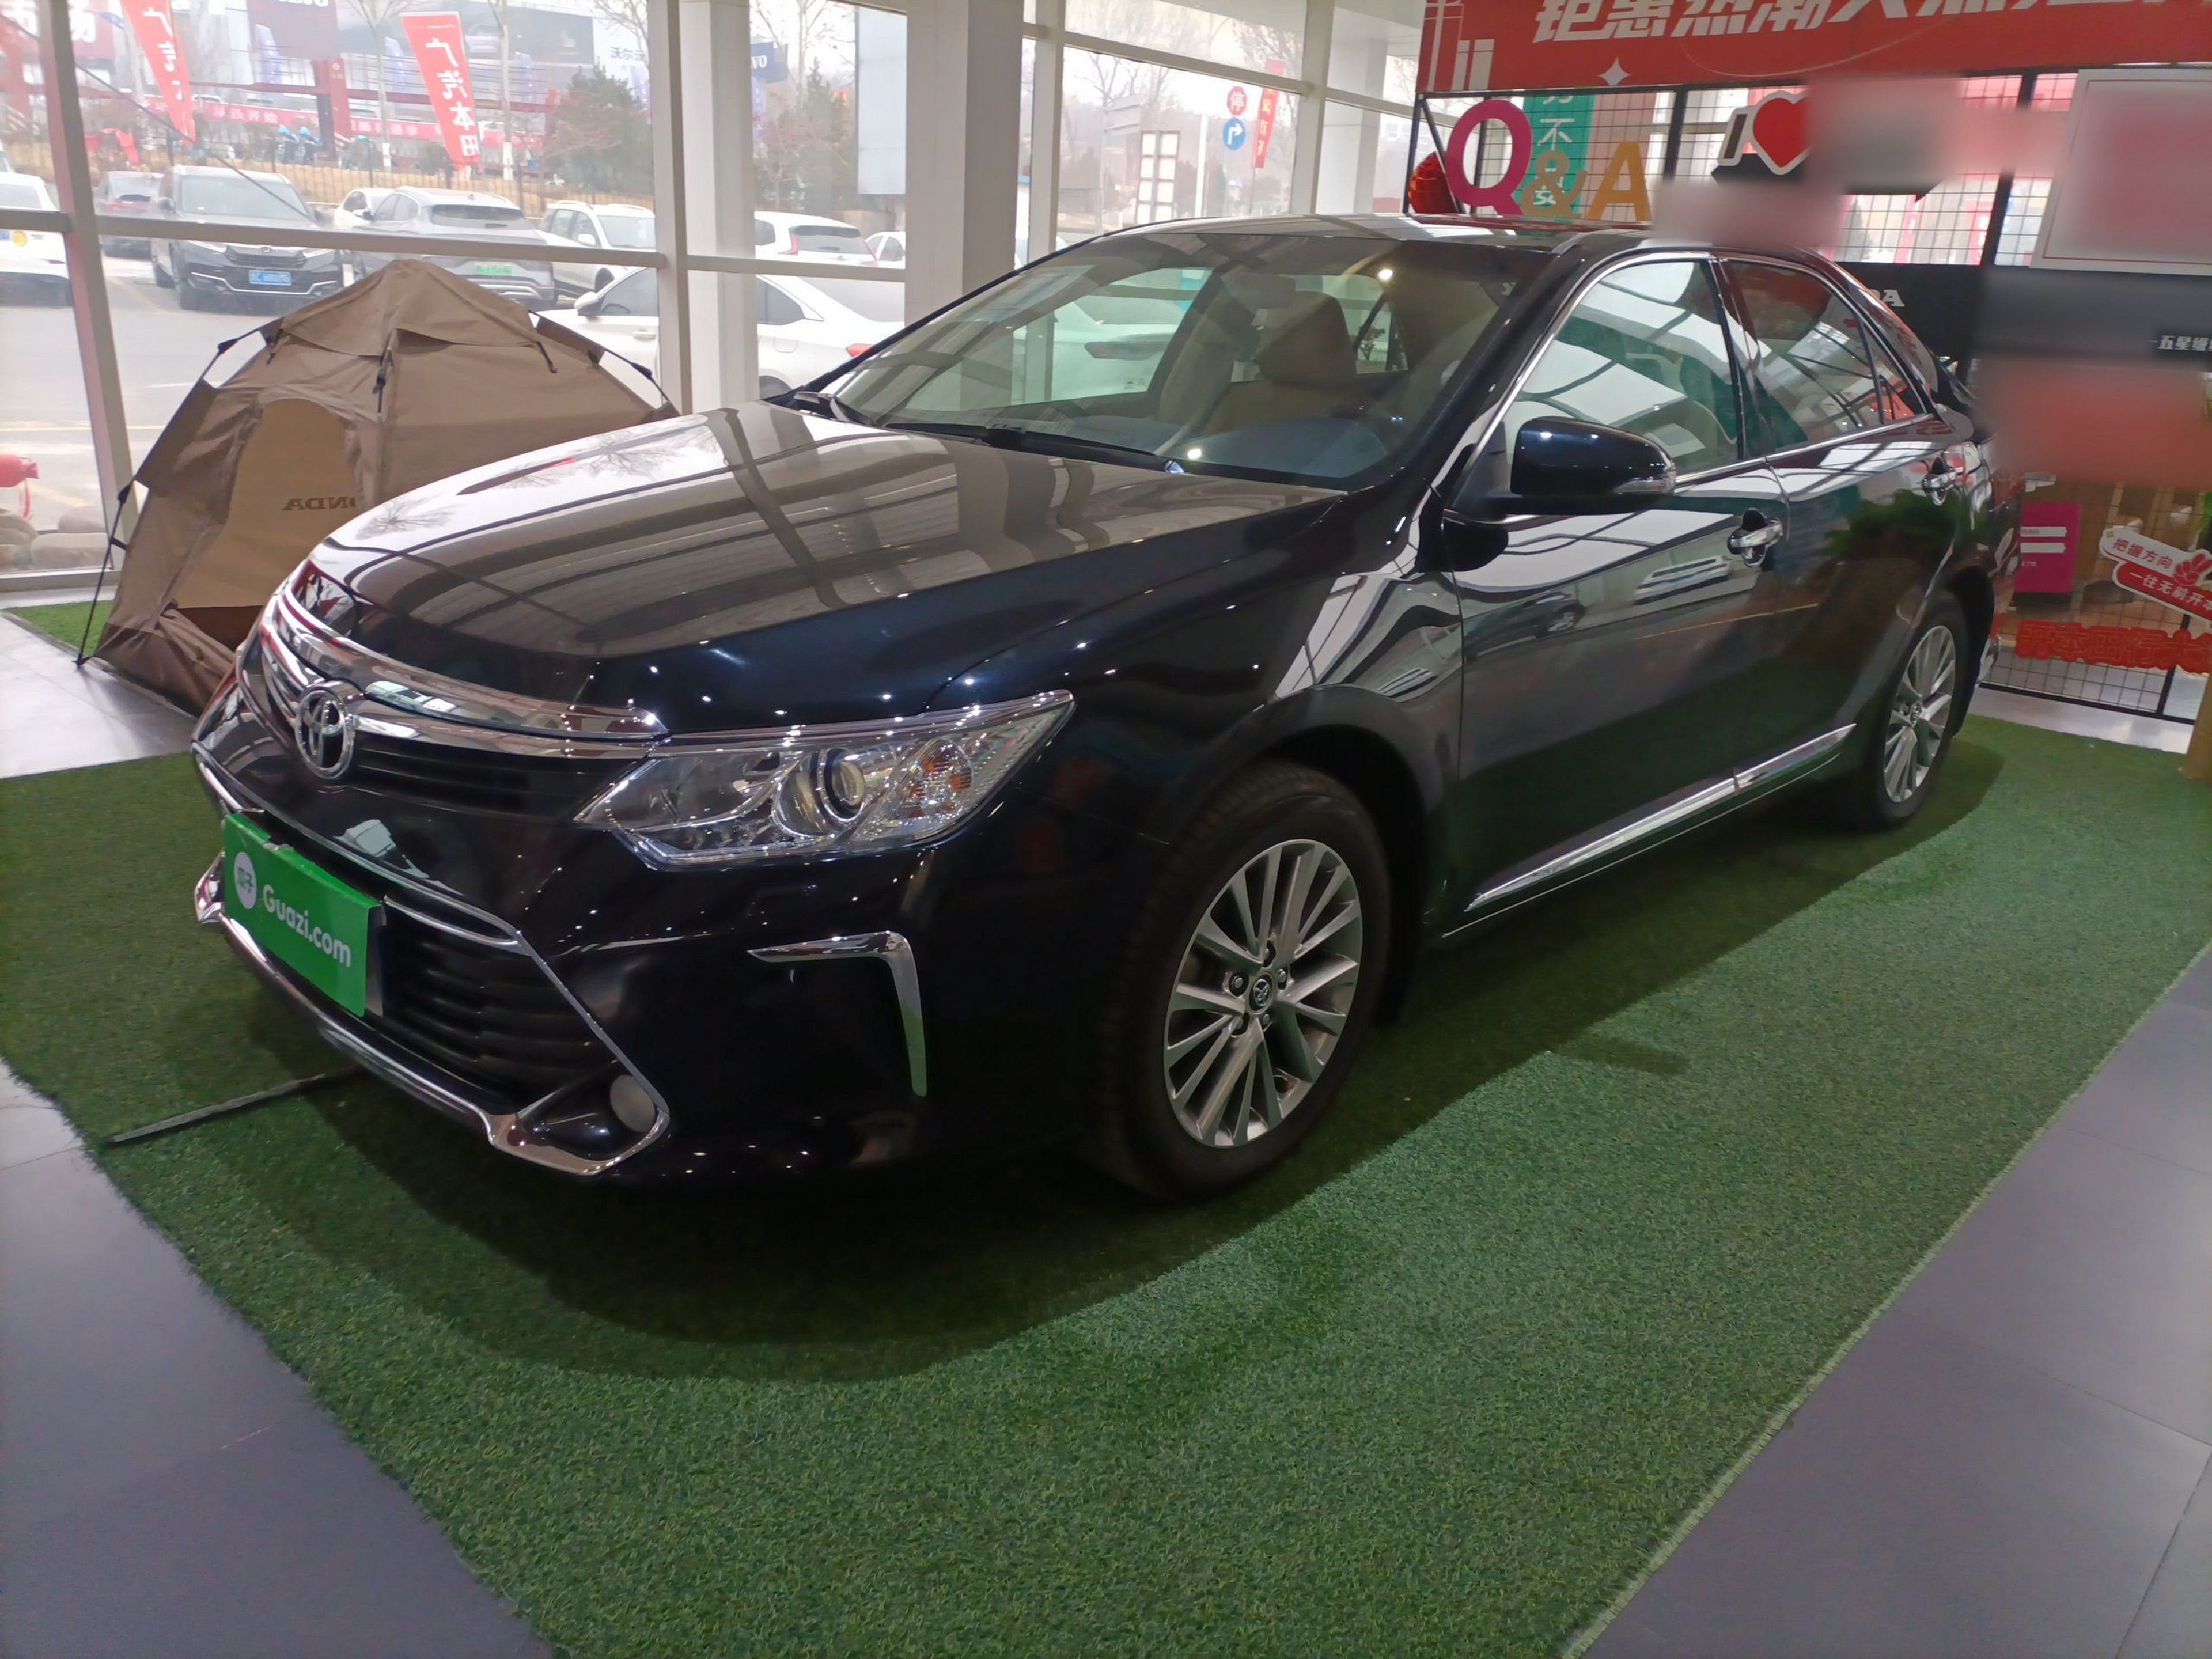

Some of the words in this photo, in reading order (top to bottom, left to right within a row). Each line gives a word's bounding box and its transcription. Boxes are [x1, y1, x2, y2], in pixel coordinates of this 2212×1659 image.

[1230, 92, 1245, 111] 停
[2113, 538, 2173, 569] 把握方向
[263, 884, 351, 968] Guazi.com
